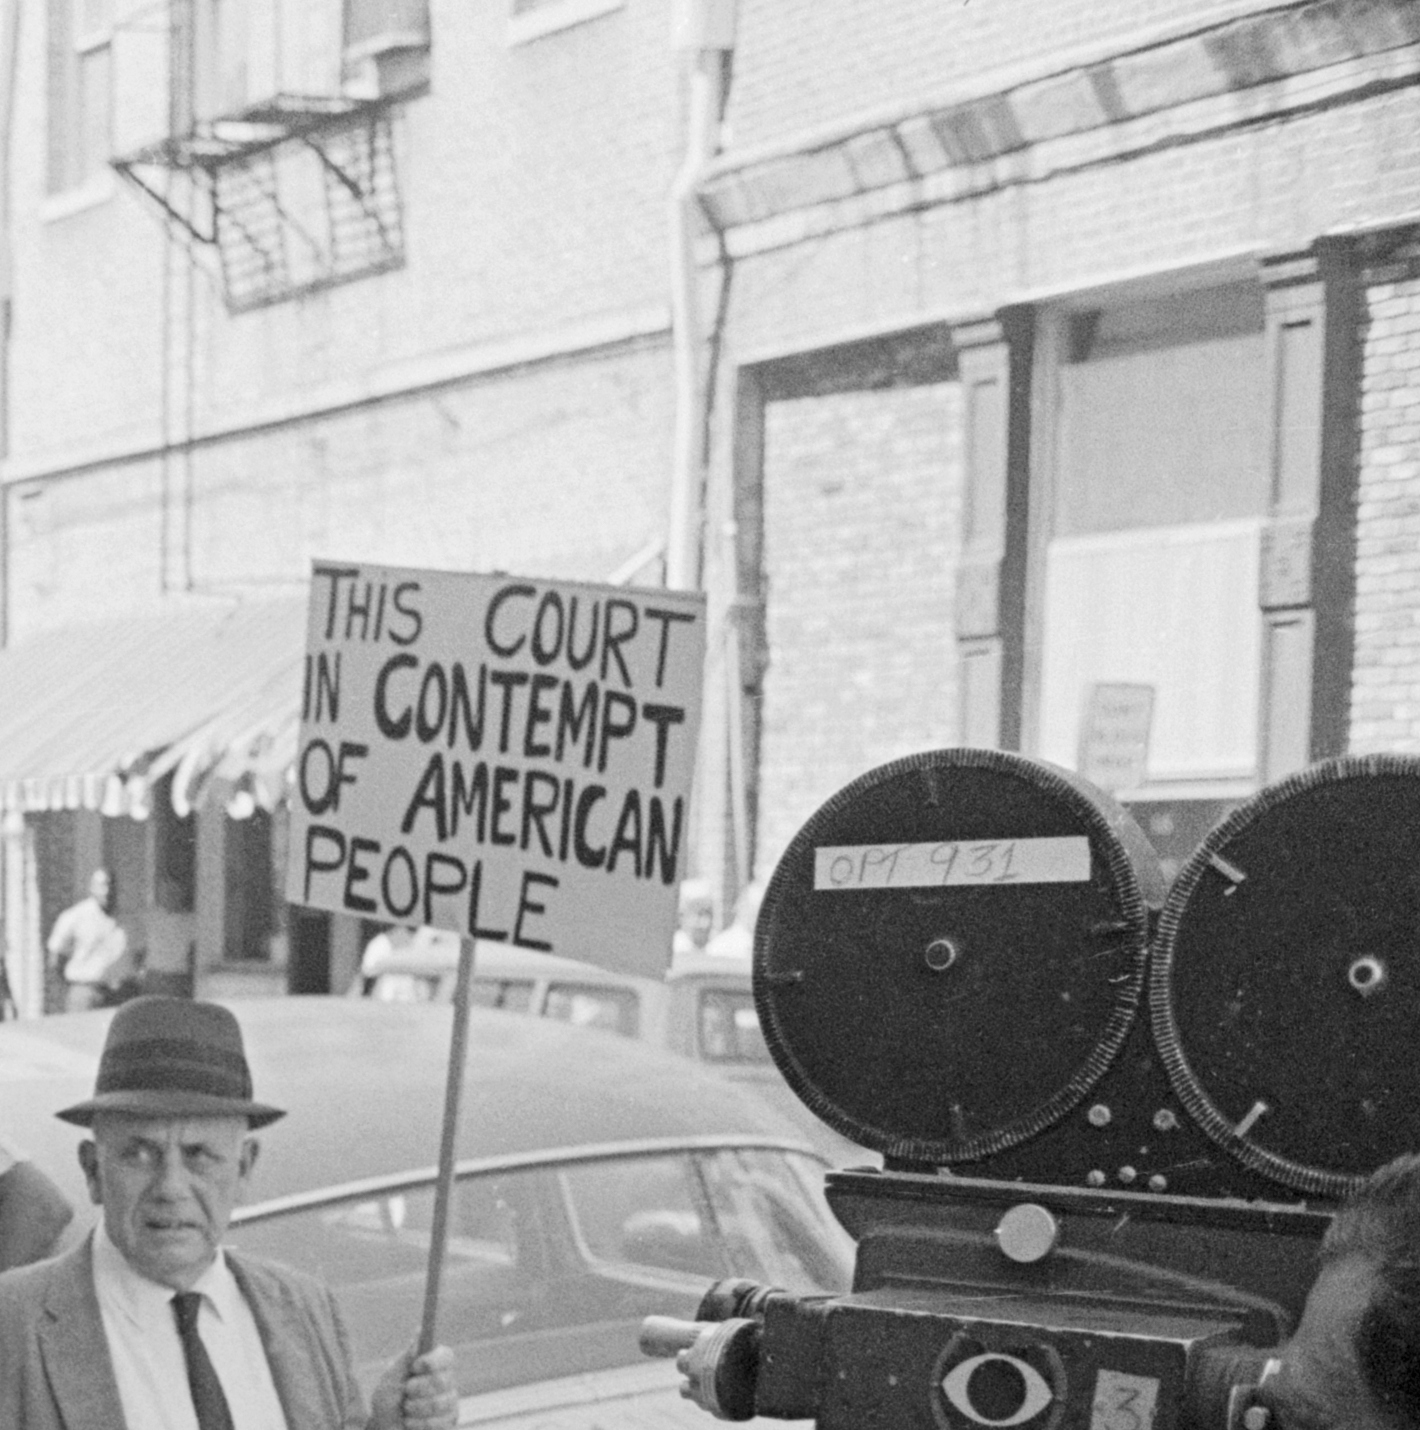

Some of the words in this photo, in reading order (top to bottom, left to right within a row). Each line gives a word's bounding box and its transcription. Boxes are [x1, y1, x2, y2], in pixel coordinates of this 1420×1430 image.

[314, 568, 422, 645] THIS
[485, 585, 696, 687] COURT
[304, 653, 340, 722] IN
[374, 653, 684, 789] CONTEMPT
[299, 739, 368, 815] OF
[401, 752, 683, 885] AMERICAN
[929, 841, 1019, 885] 931
[304, 825, 559, 951] PEOPLE
